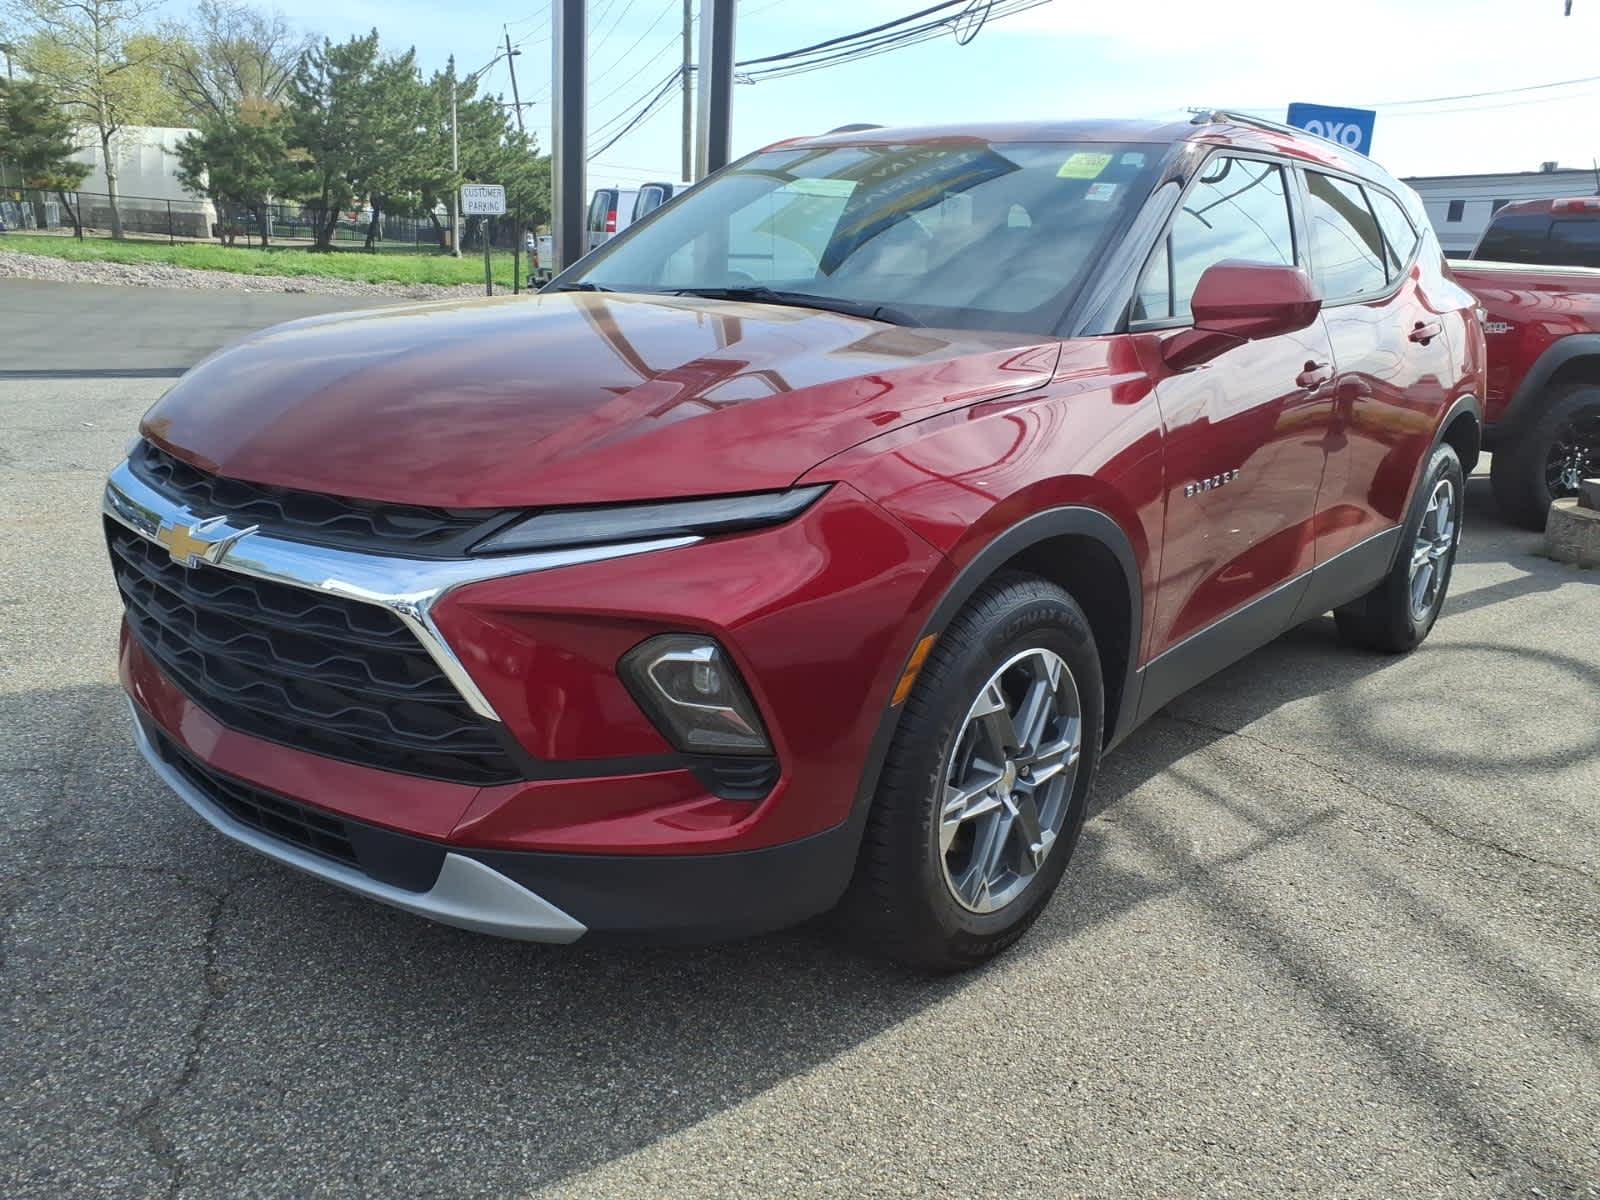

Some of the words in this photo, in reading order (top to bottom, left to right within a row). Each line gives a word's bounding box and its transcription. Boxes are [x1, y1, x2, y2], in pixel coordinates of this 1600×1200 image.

[464, 188, 502, 199] CUSTOMER
[469, 201, 499, 211] PARKING
[1185, 469, 1240, 497] BLAZER
